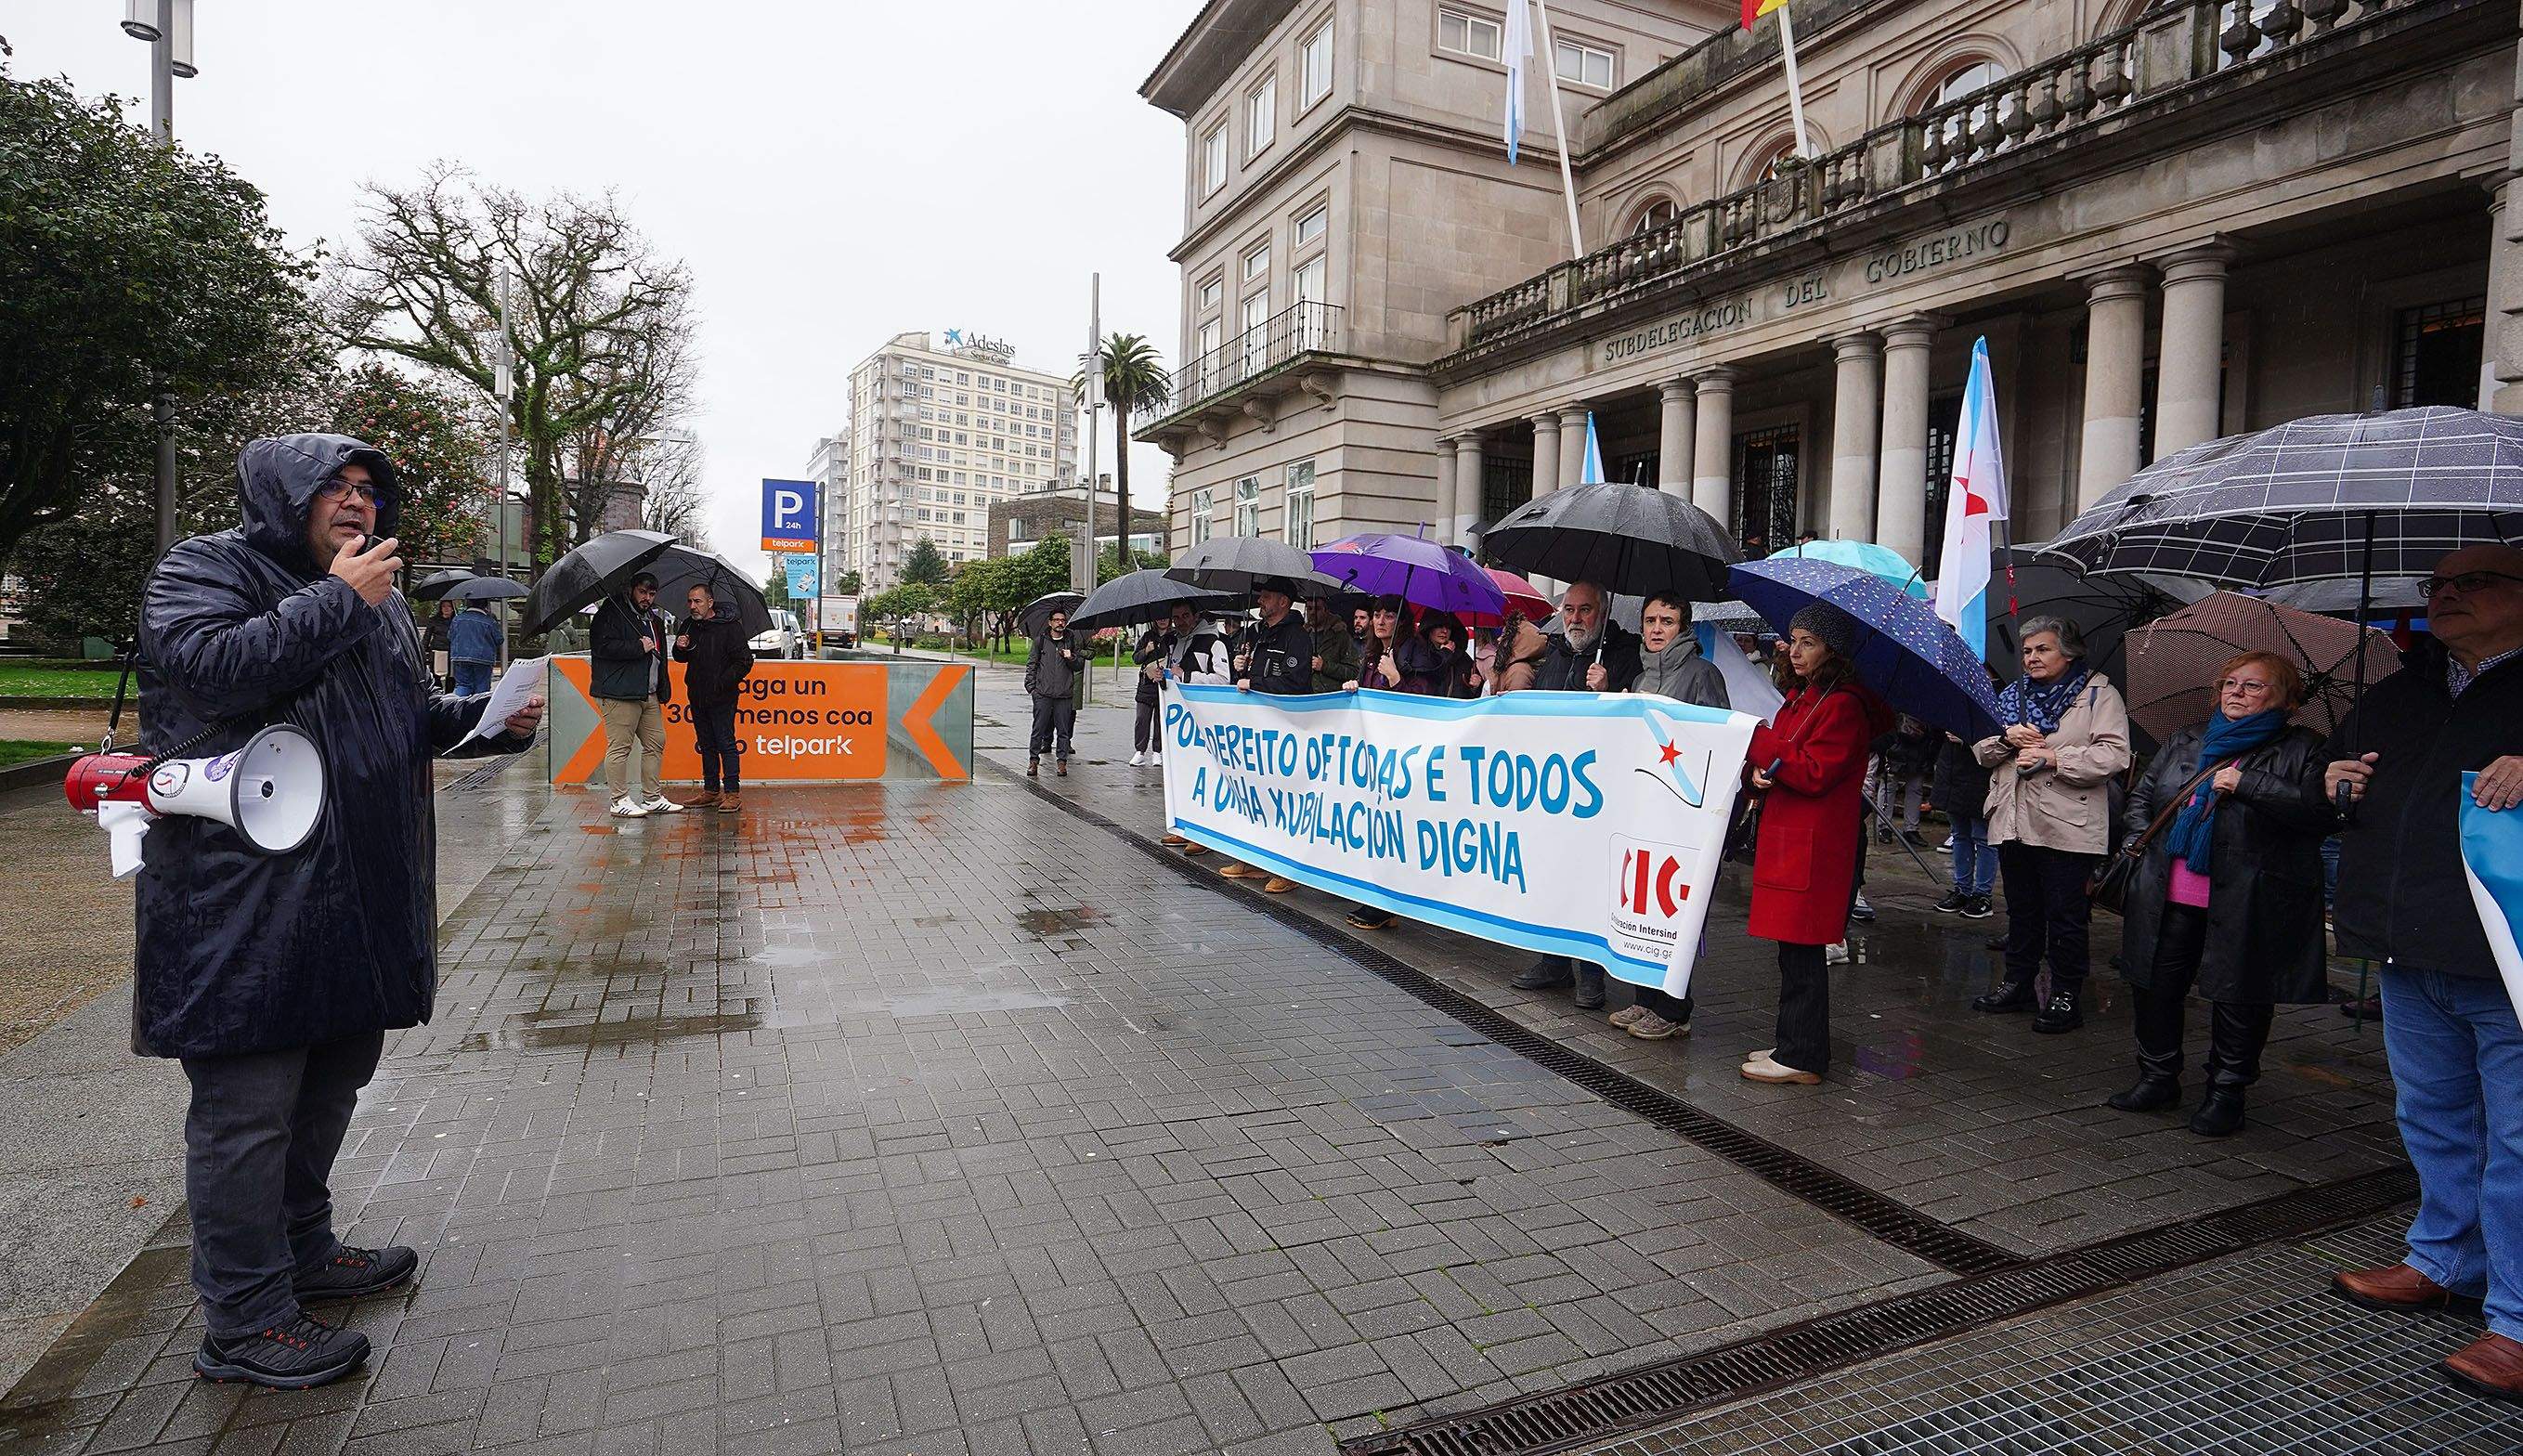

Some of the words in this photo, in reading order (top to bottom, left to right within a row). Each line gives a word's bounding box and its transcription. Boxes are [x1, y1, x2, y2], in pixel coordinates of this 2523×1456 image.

[1785, 276, 1827, 308] DEL
[1865, 220, 2010, 283] GOBIERNO
[967, 332, 1016, 356] Adeslas
[774, 490, 803, 528] P
[772, 540, 804, 549] telpark
[787, 558, 816, 566] telpark
[737, 679, 787, 701] aga
[794, 679, 826, 696] un
[735, 708, 819, 725] menos
[826, 708, 873, 725] coa
[756, 734, 852, 760] telpark
[1338, 735, 1423, 801] TODAS
[1427, 745, 1448, 802] E
[1459, 746, 1604, 819] TODOS
[1191, 767, 1206, 808] A
[1267, 786, 1407, 864] XUBILACIÓN
[1416, 817, 1528, 895] DIGNA
[1620, 847, 1691, 919] CIG
[1639, 923, 1678, 940] Intersind
[1622, 941, 1672, 960] www.cig.ga
